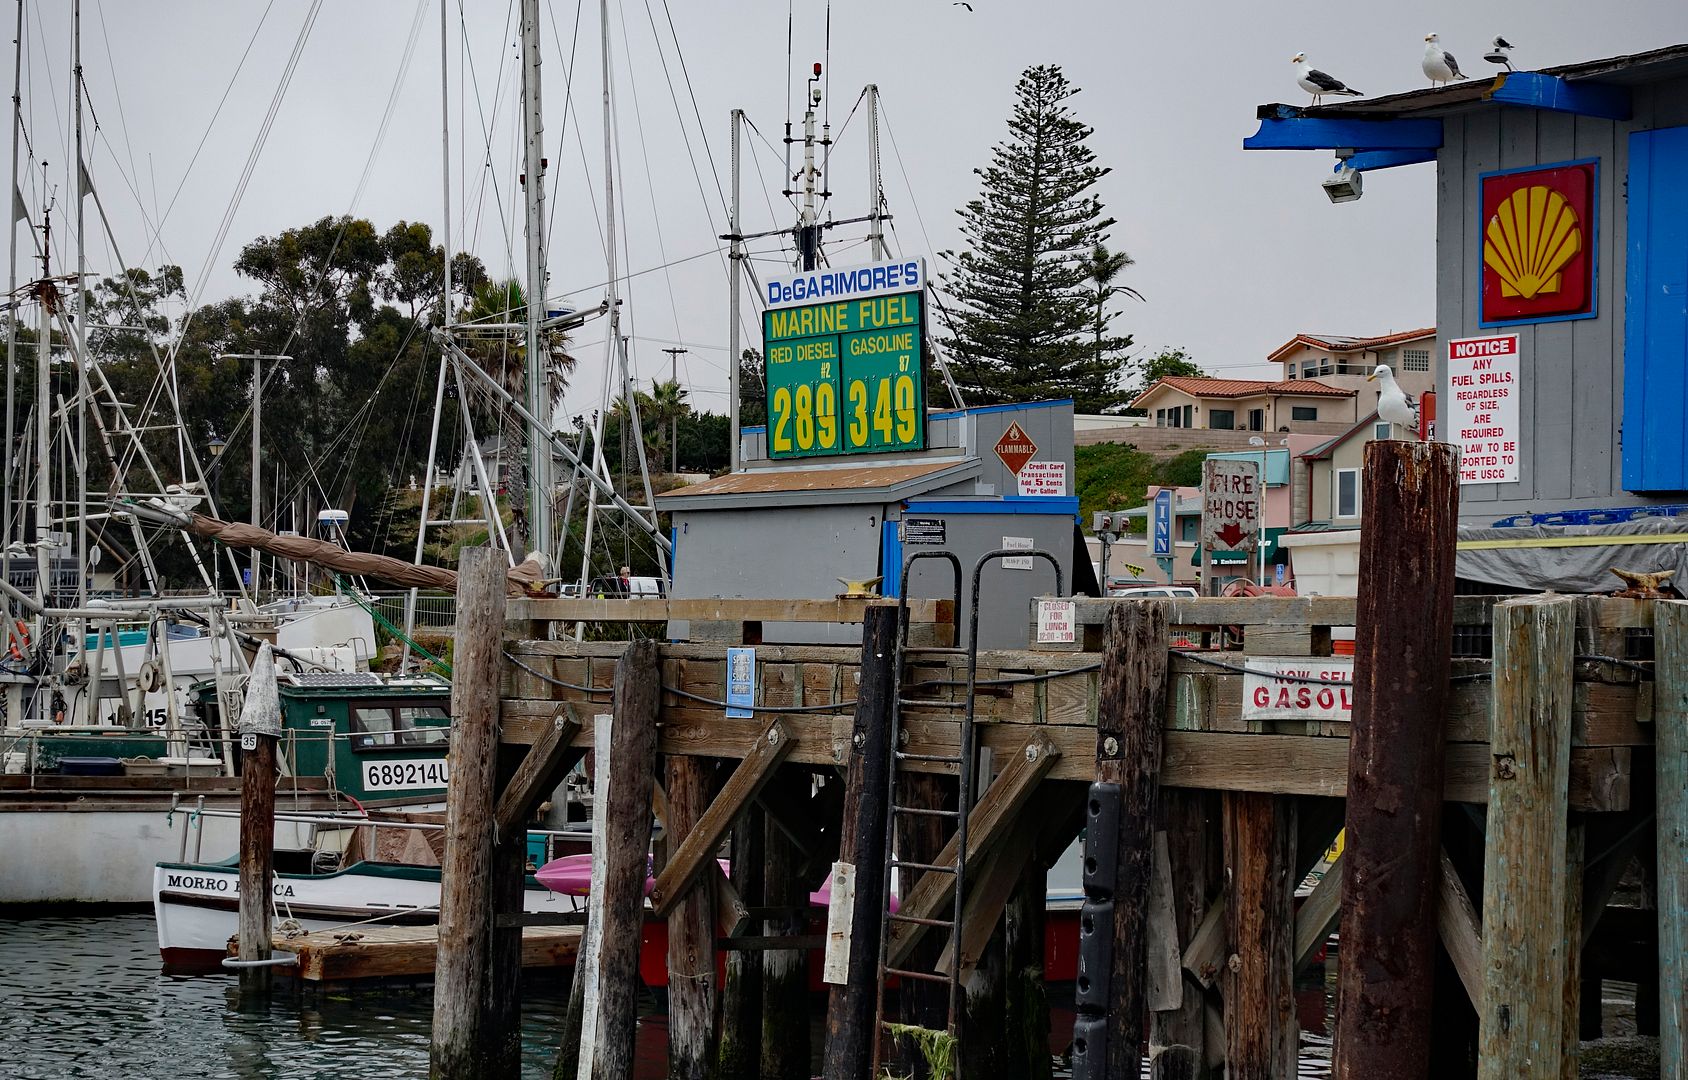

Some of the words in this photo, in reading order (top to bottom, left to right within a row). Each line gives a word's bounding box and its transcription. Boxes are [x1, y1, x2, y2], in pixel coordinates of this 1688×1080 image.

[768, 262, 918, 304] DeGARIMORE'S
[772, 303, 848, 338] MARINE
[859, 297, 913, 328] FUEL
[850, 333, 912, 356] GASOLINE
[1456, 340, 1509, 357] NOTICE
[771, 346, 792, 364] RED
[797, 342, 836, 361] DIESEL
[899, 355, 910, 372] 87
[1472, 359, 1492, 370] ANY
[1452, 375, 1474, 386] FUEL
[1479, 372, 1514, 385] SPILLS,
[1457, 388, 1508, 400] REGARDLESS
[850, 375, 916, 447] 349
[1465, 402, 1476, 411] OF
[1480, 401, 1500, 411] SIZE,
[774, 382, 836, 451] 289
[1473, 414, 1491, 424] ARE
[1461, 427, 1504, 439] REQUIRED
[998, 444, 1034, 454] FLAMMABLE
[1465, 444, 1483, 453] LAW
[1488, 442, 1499, 452] TO
[1503, 442, 1515, 451] BE
[1460, 456, 1497, 466] PORTED
[1502, 455, 1514, 465] TO
[1460, 470, 1476, 480] THE
[1481, 469, 1505, 479] USCG
[1213, 474, 1254, 494] FIRE
[1213, 500, 1255, 519] HOSE
[1156, 505, 1168, 552] INN
[1044, 602, 1069, 611] CLOSED
[1050, 612, 1063, 620] FOR
[1045, 622, 1068, 631] LUNCH
[1061, 632, 1073, 641] 1:00
[1275, 670, 1310, 685] NOW
[1320, 671, 1353, 686] SEL
[1253, 687, 1353, 710] GASOL
[243, 736, 255, 747] 35
[368, 763, 449, 786] 689214U
[168, 875, 228, 892] MORRO
